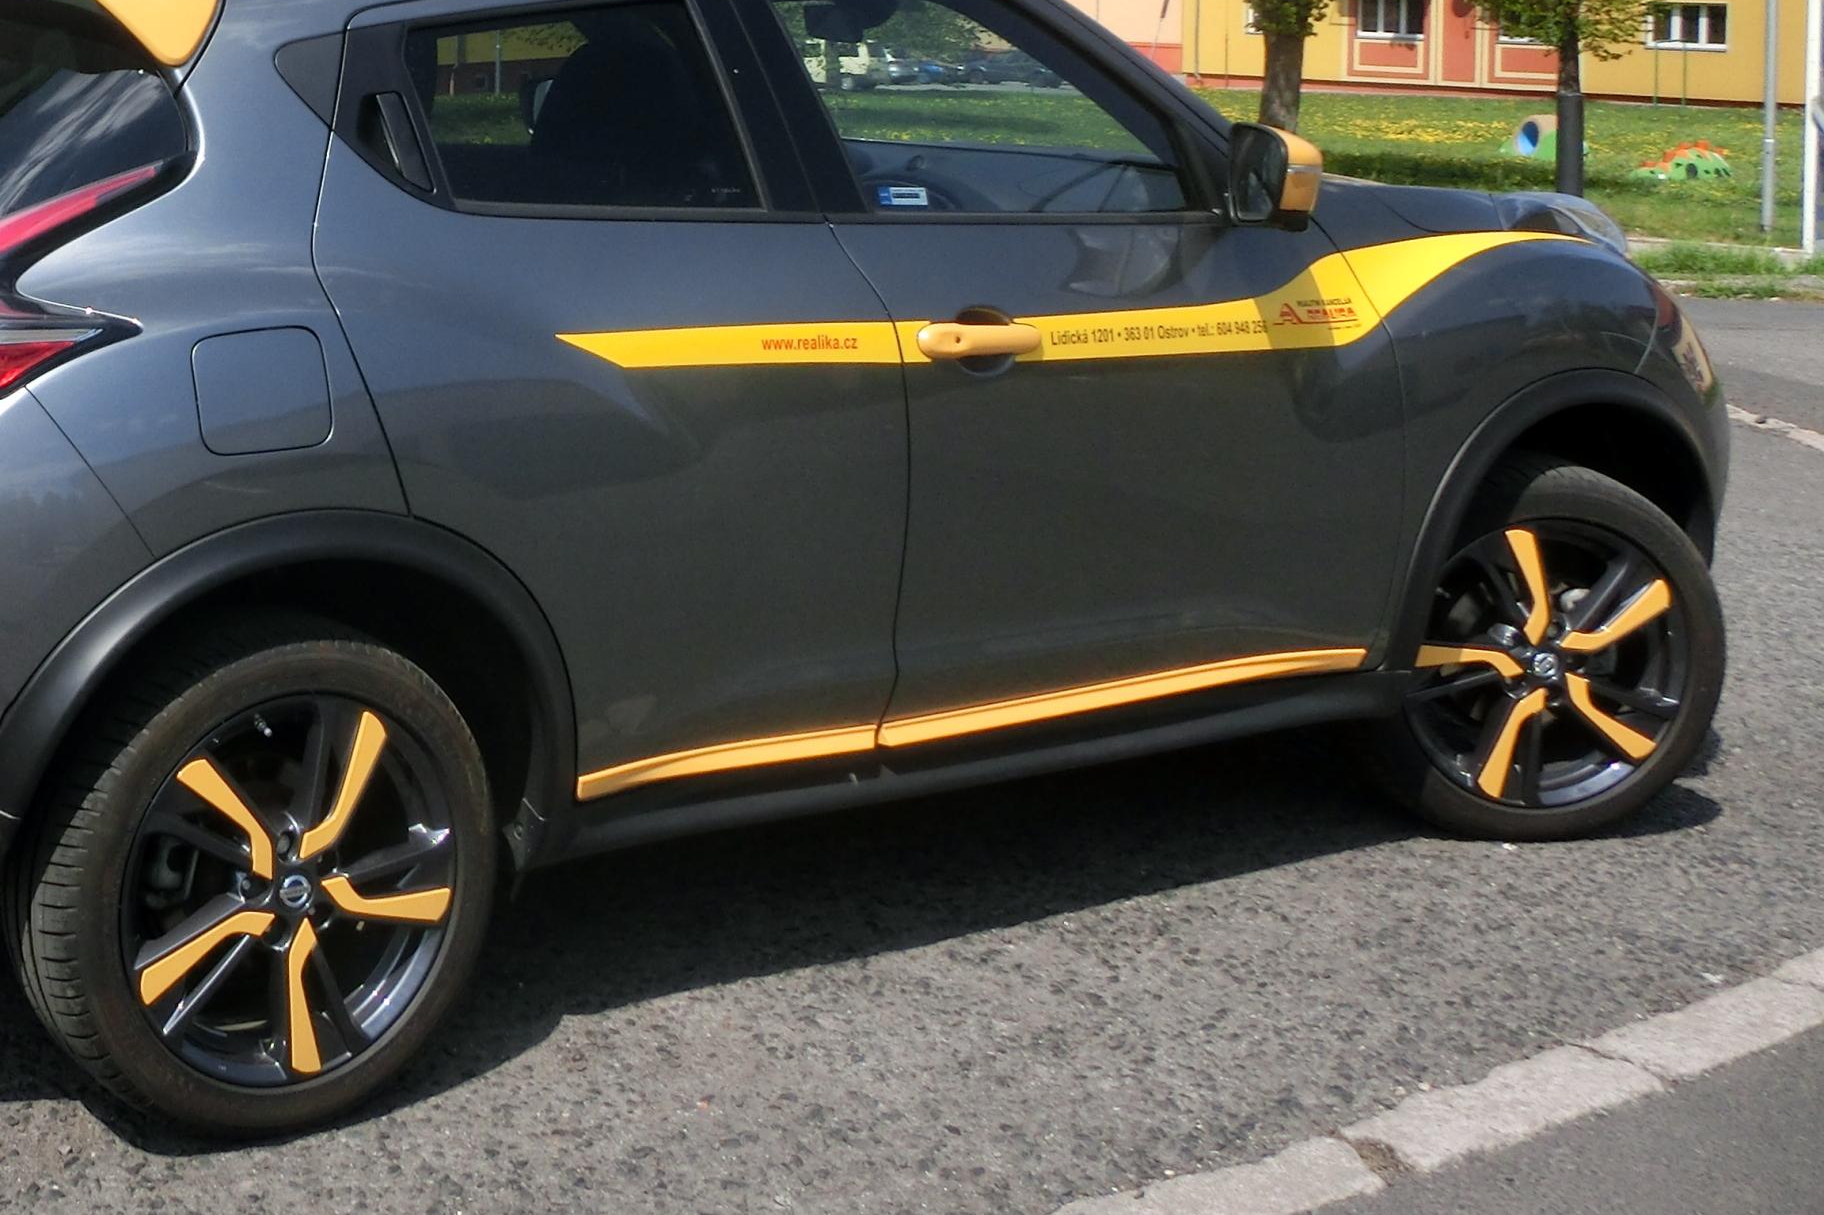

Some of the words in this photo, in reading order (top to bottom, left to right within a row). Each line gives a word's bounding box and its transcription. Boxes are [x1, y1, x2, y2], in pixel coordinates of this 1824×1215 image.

[761, 334, 858, 350] www.realika.cz
[1051, 327, 1088, 346] Lidická
[1091, 328, 1115, 343] 1201
[1143, 326, 1155, 340] 01
[1157, 325, 1190, 339] Ostrov
